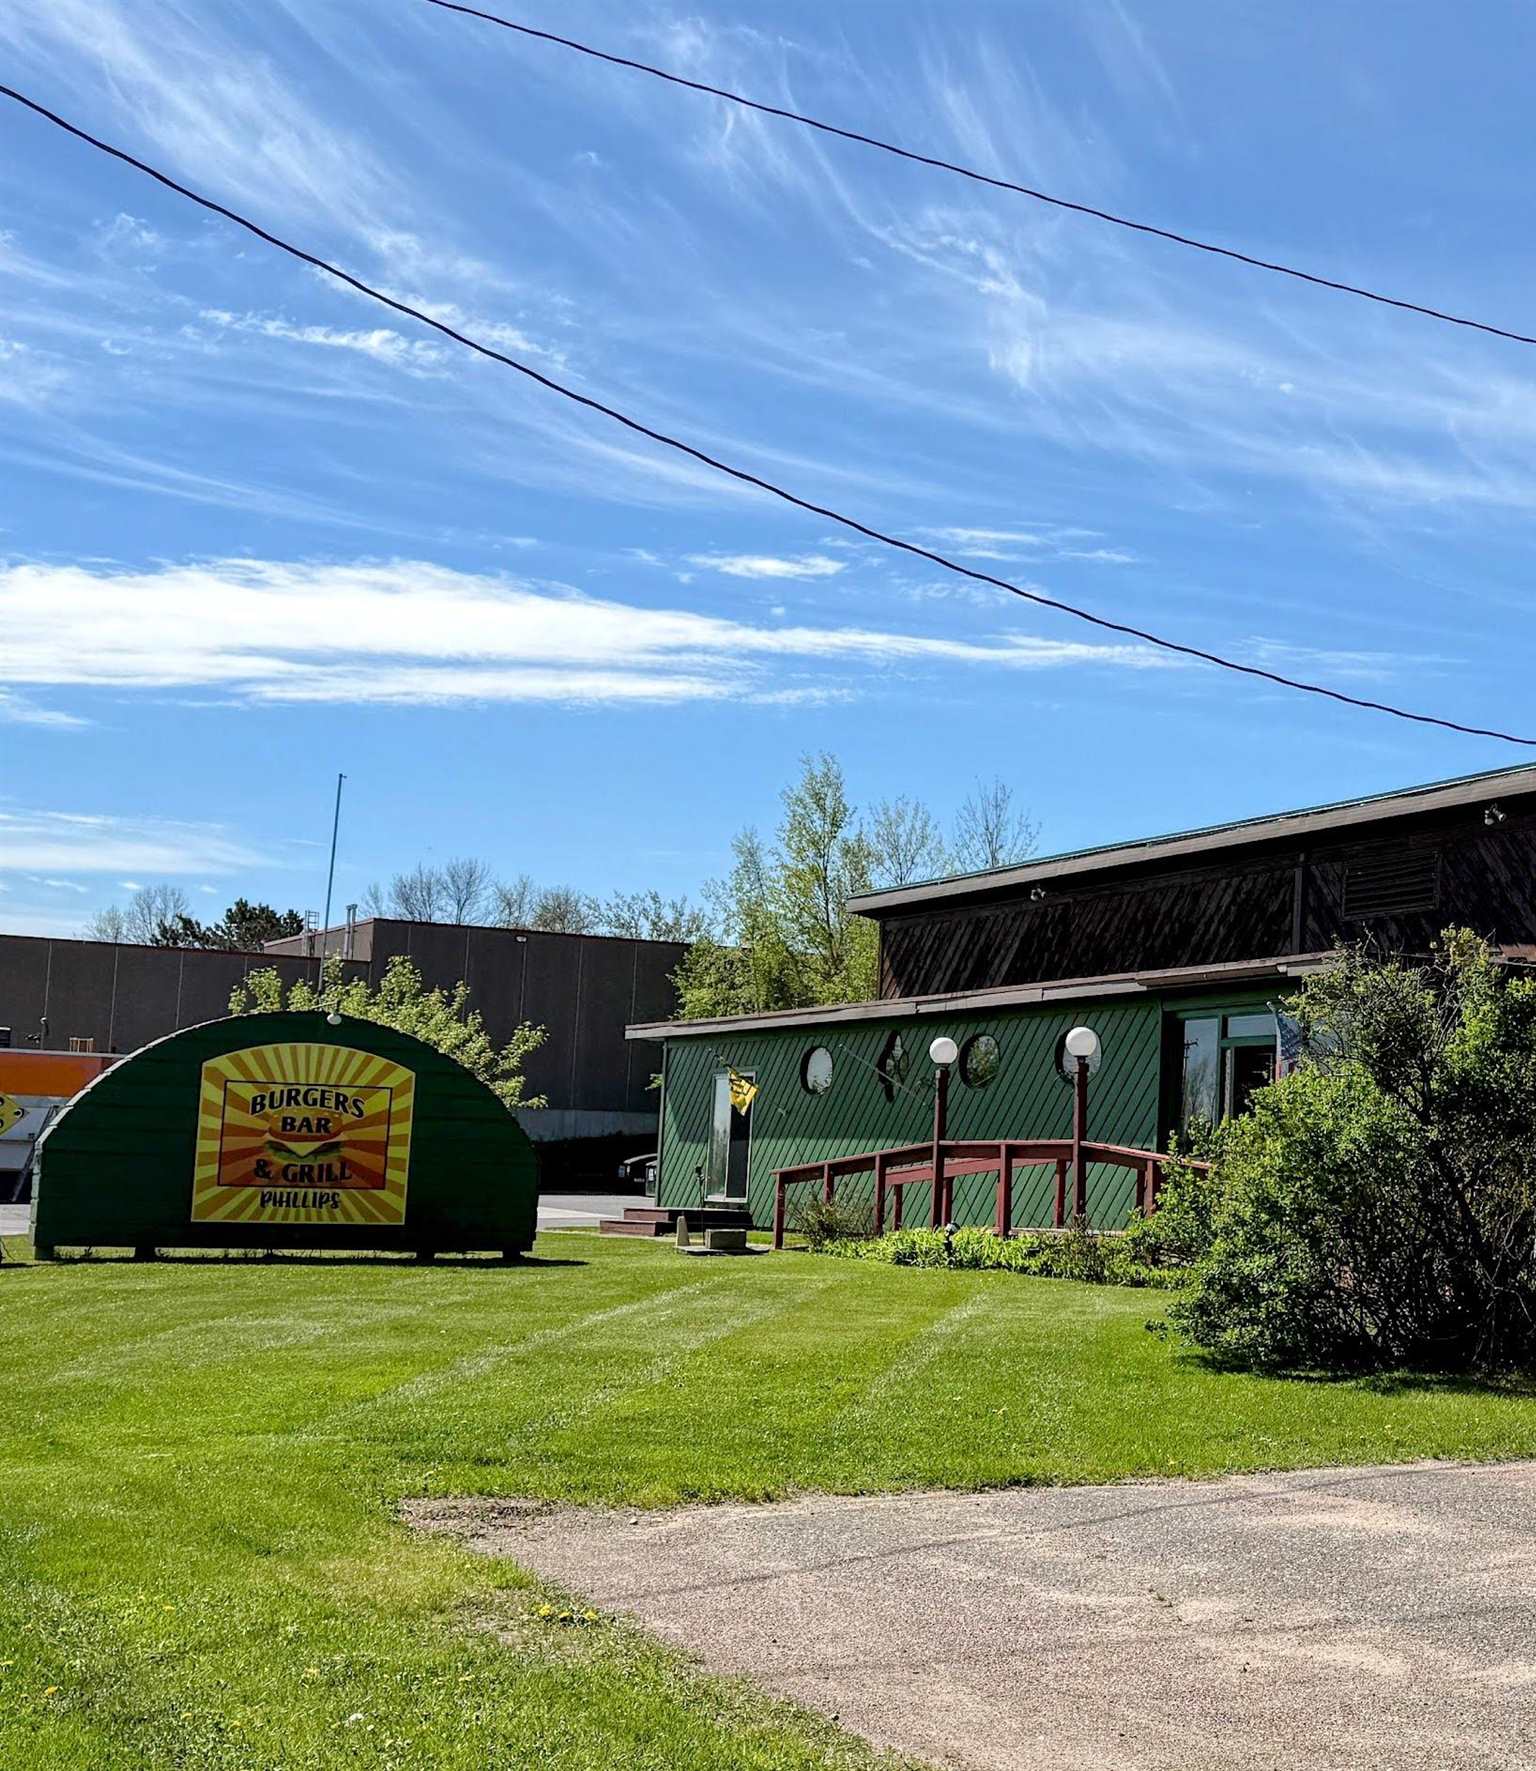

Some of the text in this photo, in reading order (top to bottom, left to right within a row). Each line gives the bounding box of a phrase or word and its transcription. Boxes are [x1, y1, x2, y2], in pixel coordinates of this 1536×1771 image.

[250, 1088, 365, 1119] BURGERS
[281, 1116, 332, 1134] BAR
[254, 1158, 352, 1184] & GRILL
[260, 1190, 341, 1209] PHILLIPS
